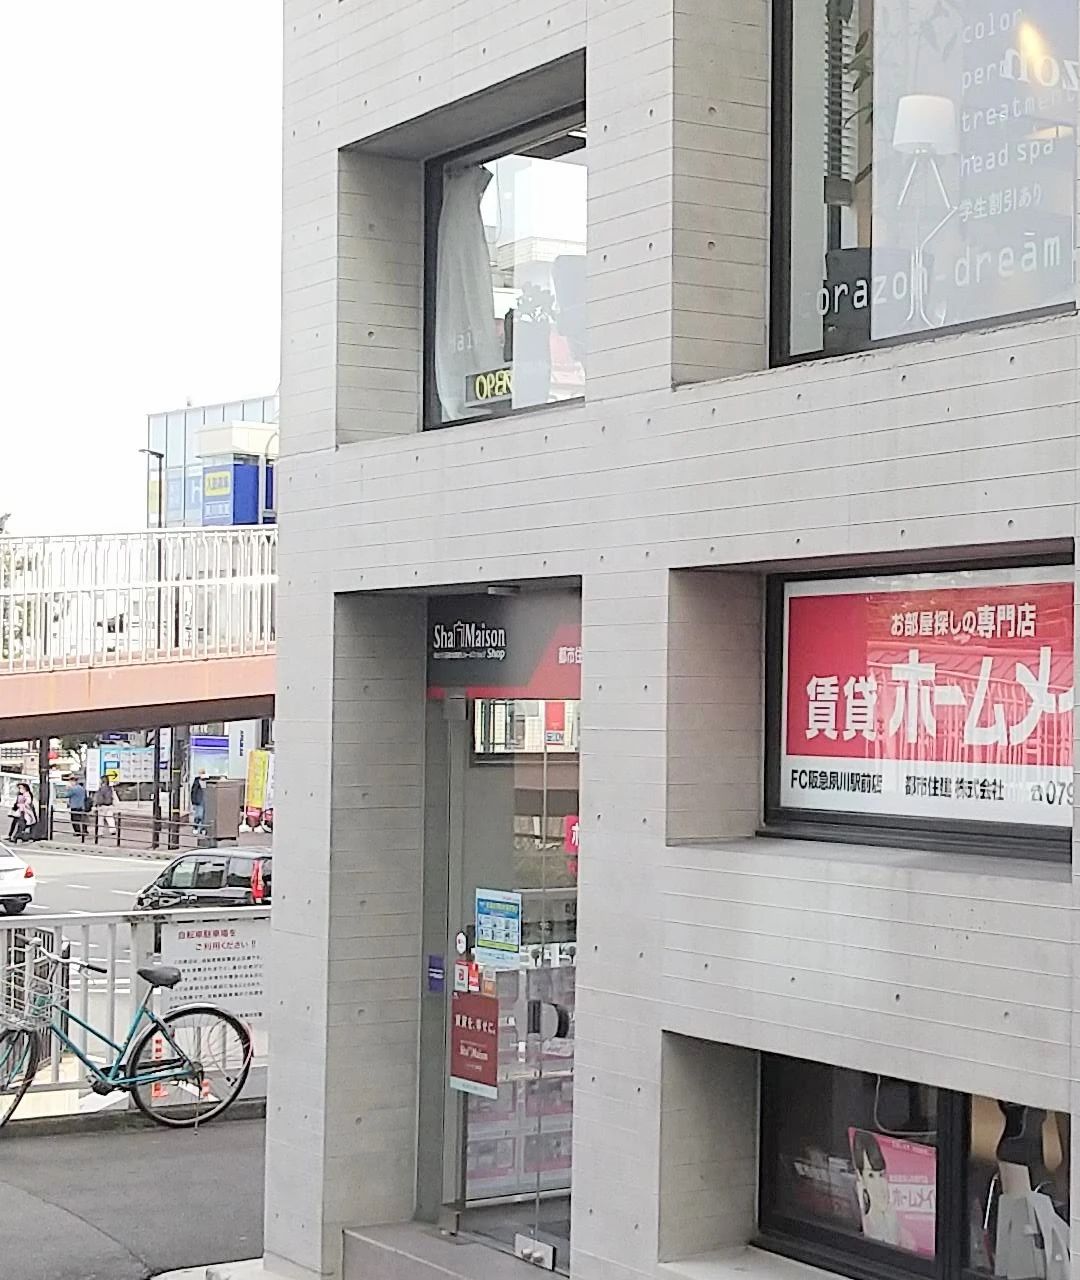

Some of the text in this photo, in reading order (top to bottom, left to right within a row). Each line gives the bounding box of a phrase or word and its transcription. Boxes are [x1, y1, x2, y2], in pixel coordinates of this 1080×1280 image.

[963, 7, 1023, 43] color
[960, 139, 1055, 176] head spa
[890, 602, 1037, 639] お部屋探しの専門店
[486, 648, 506, 661] Shop
